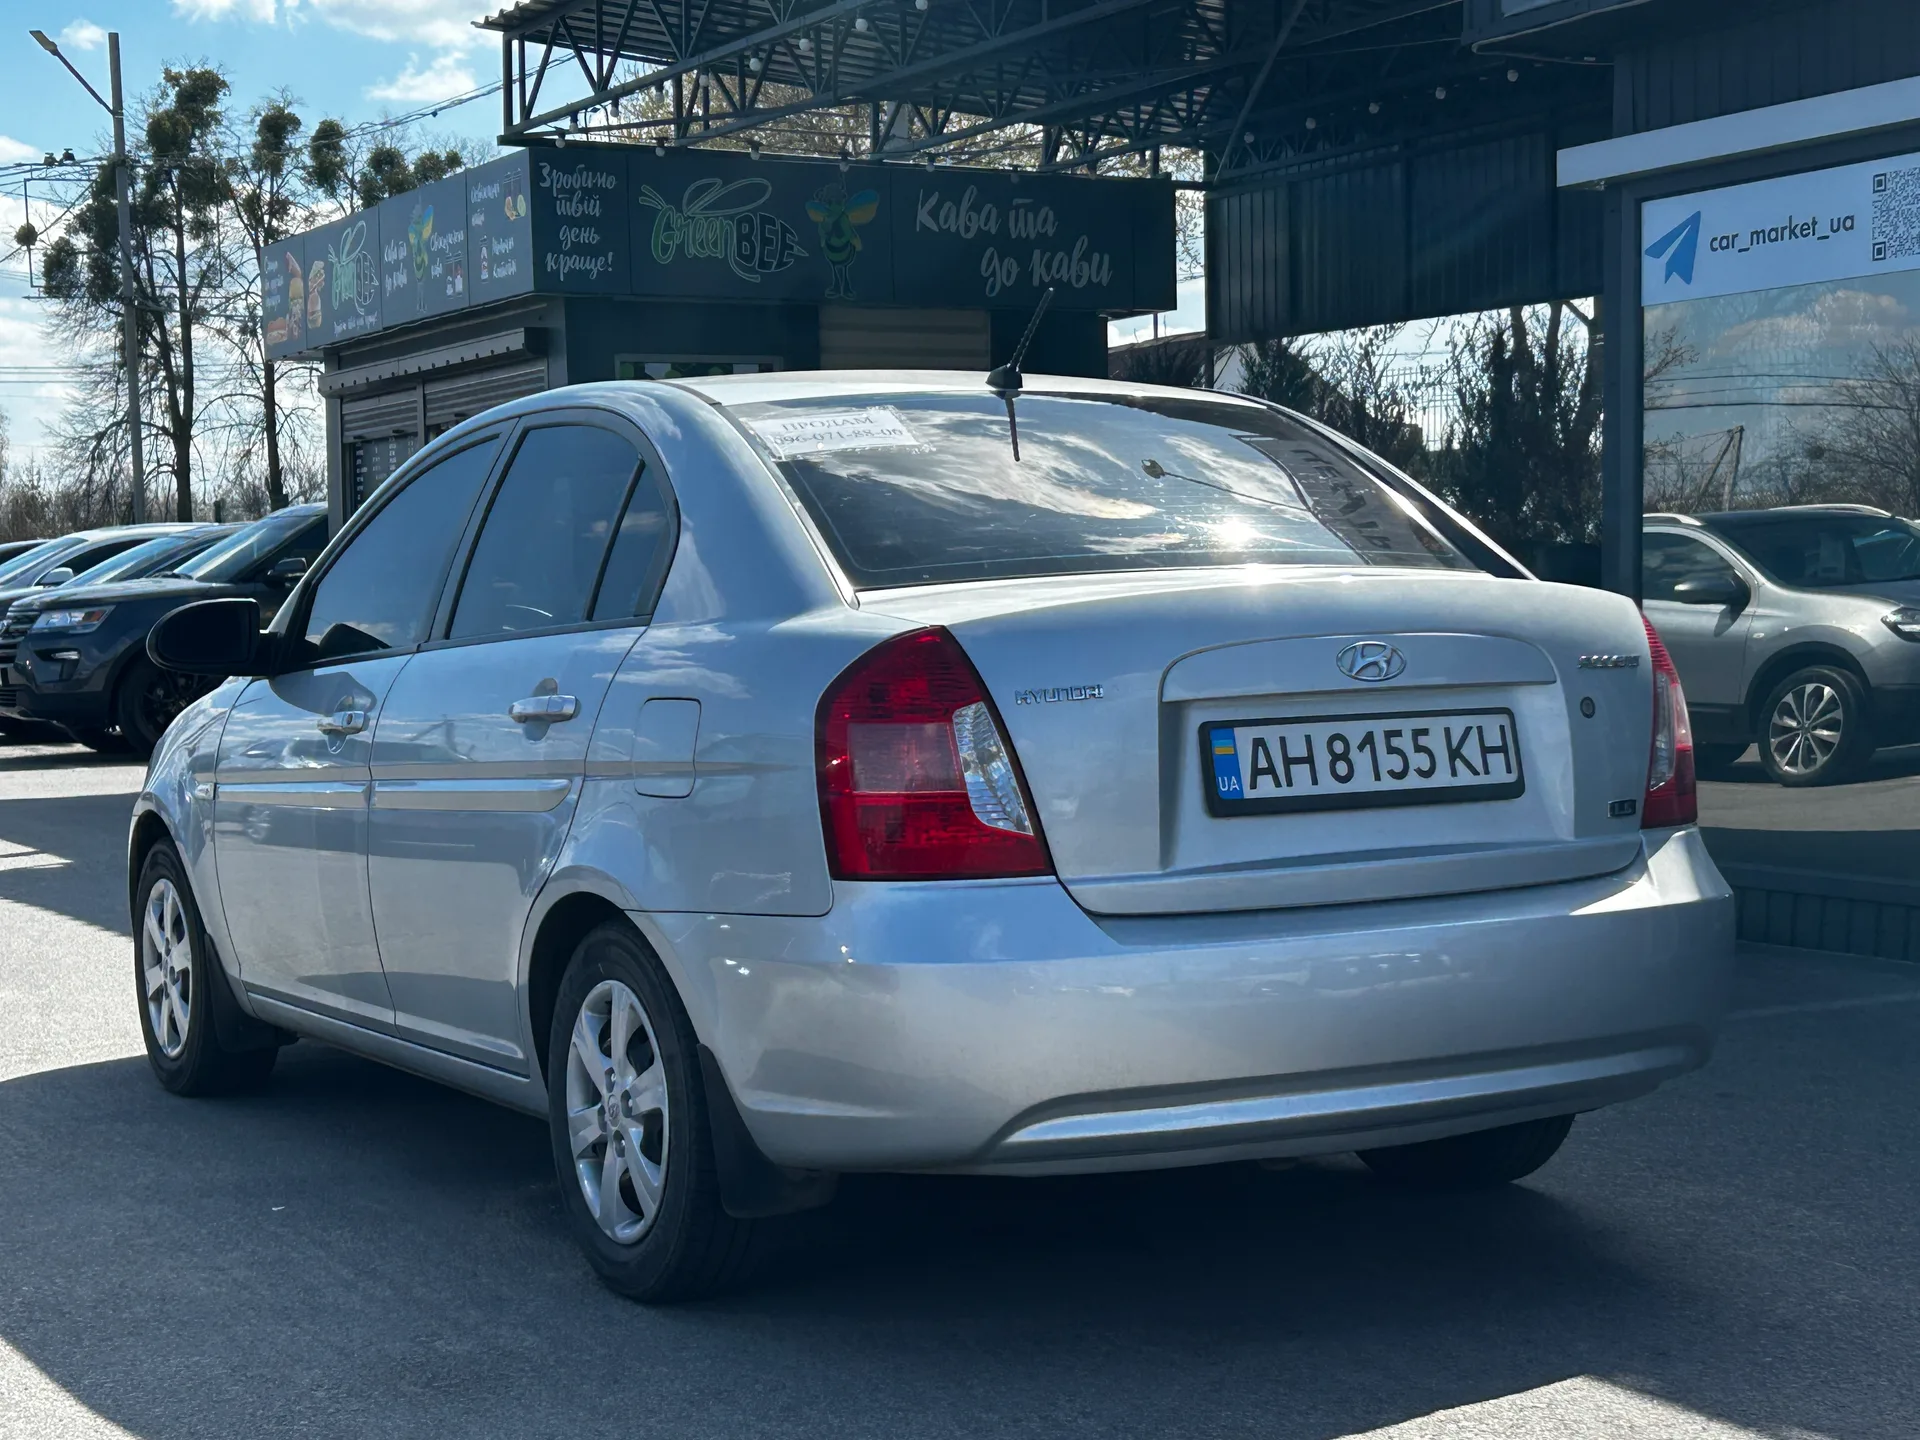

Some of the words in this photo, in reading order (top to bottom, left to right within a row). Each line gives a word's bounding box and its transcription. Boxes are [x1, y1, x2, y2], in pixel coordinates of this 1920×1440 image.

[539, 162, 617, 197] Зробимо
[556, 190, 602, 217] твій
[916, 185, 1001, 239] Кава
[1009, 198, 1058, 240] та
[559, 224, 600, 250] день
[1709, 214, 1855, 253] car_market_ua
[545, 251, 613, 281] краще!
[980, 247, 1020, 297] до
[1029, 235, 1113, 289] кави
[782, 416, 874, 432] ПРОДАМ
[1014, 684, 1104, 705] HYUNDAI
[1218, 776, 1240, 792] UA
